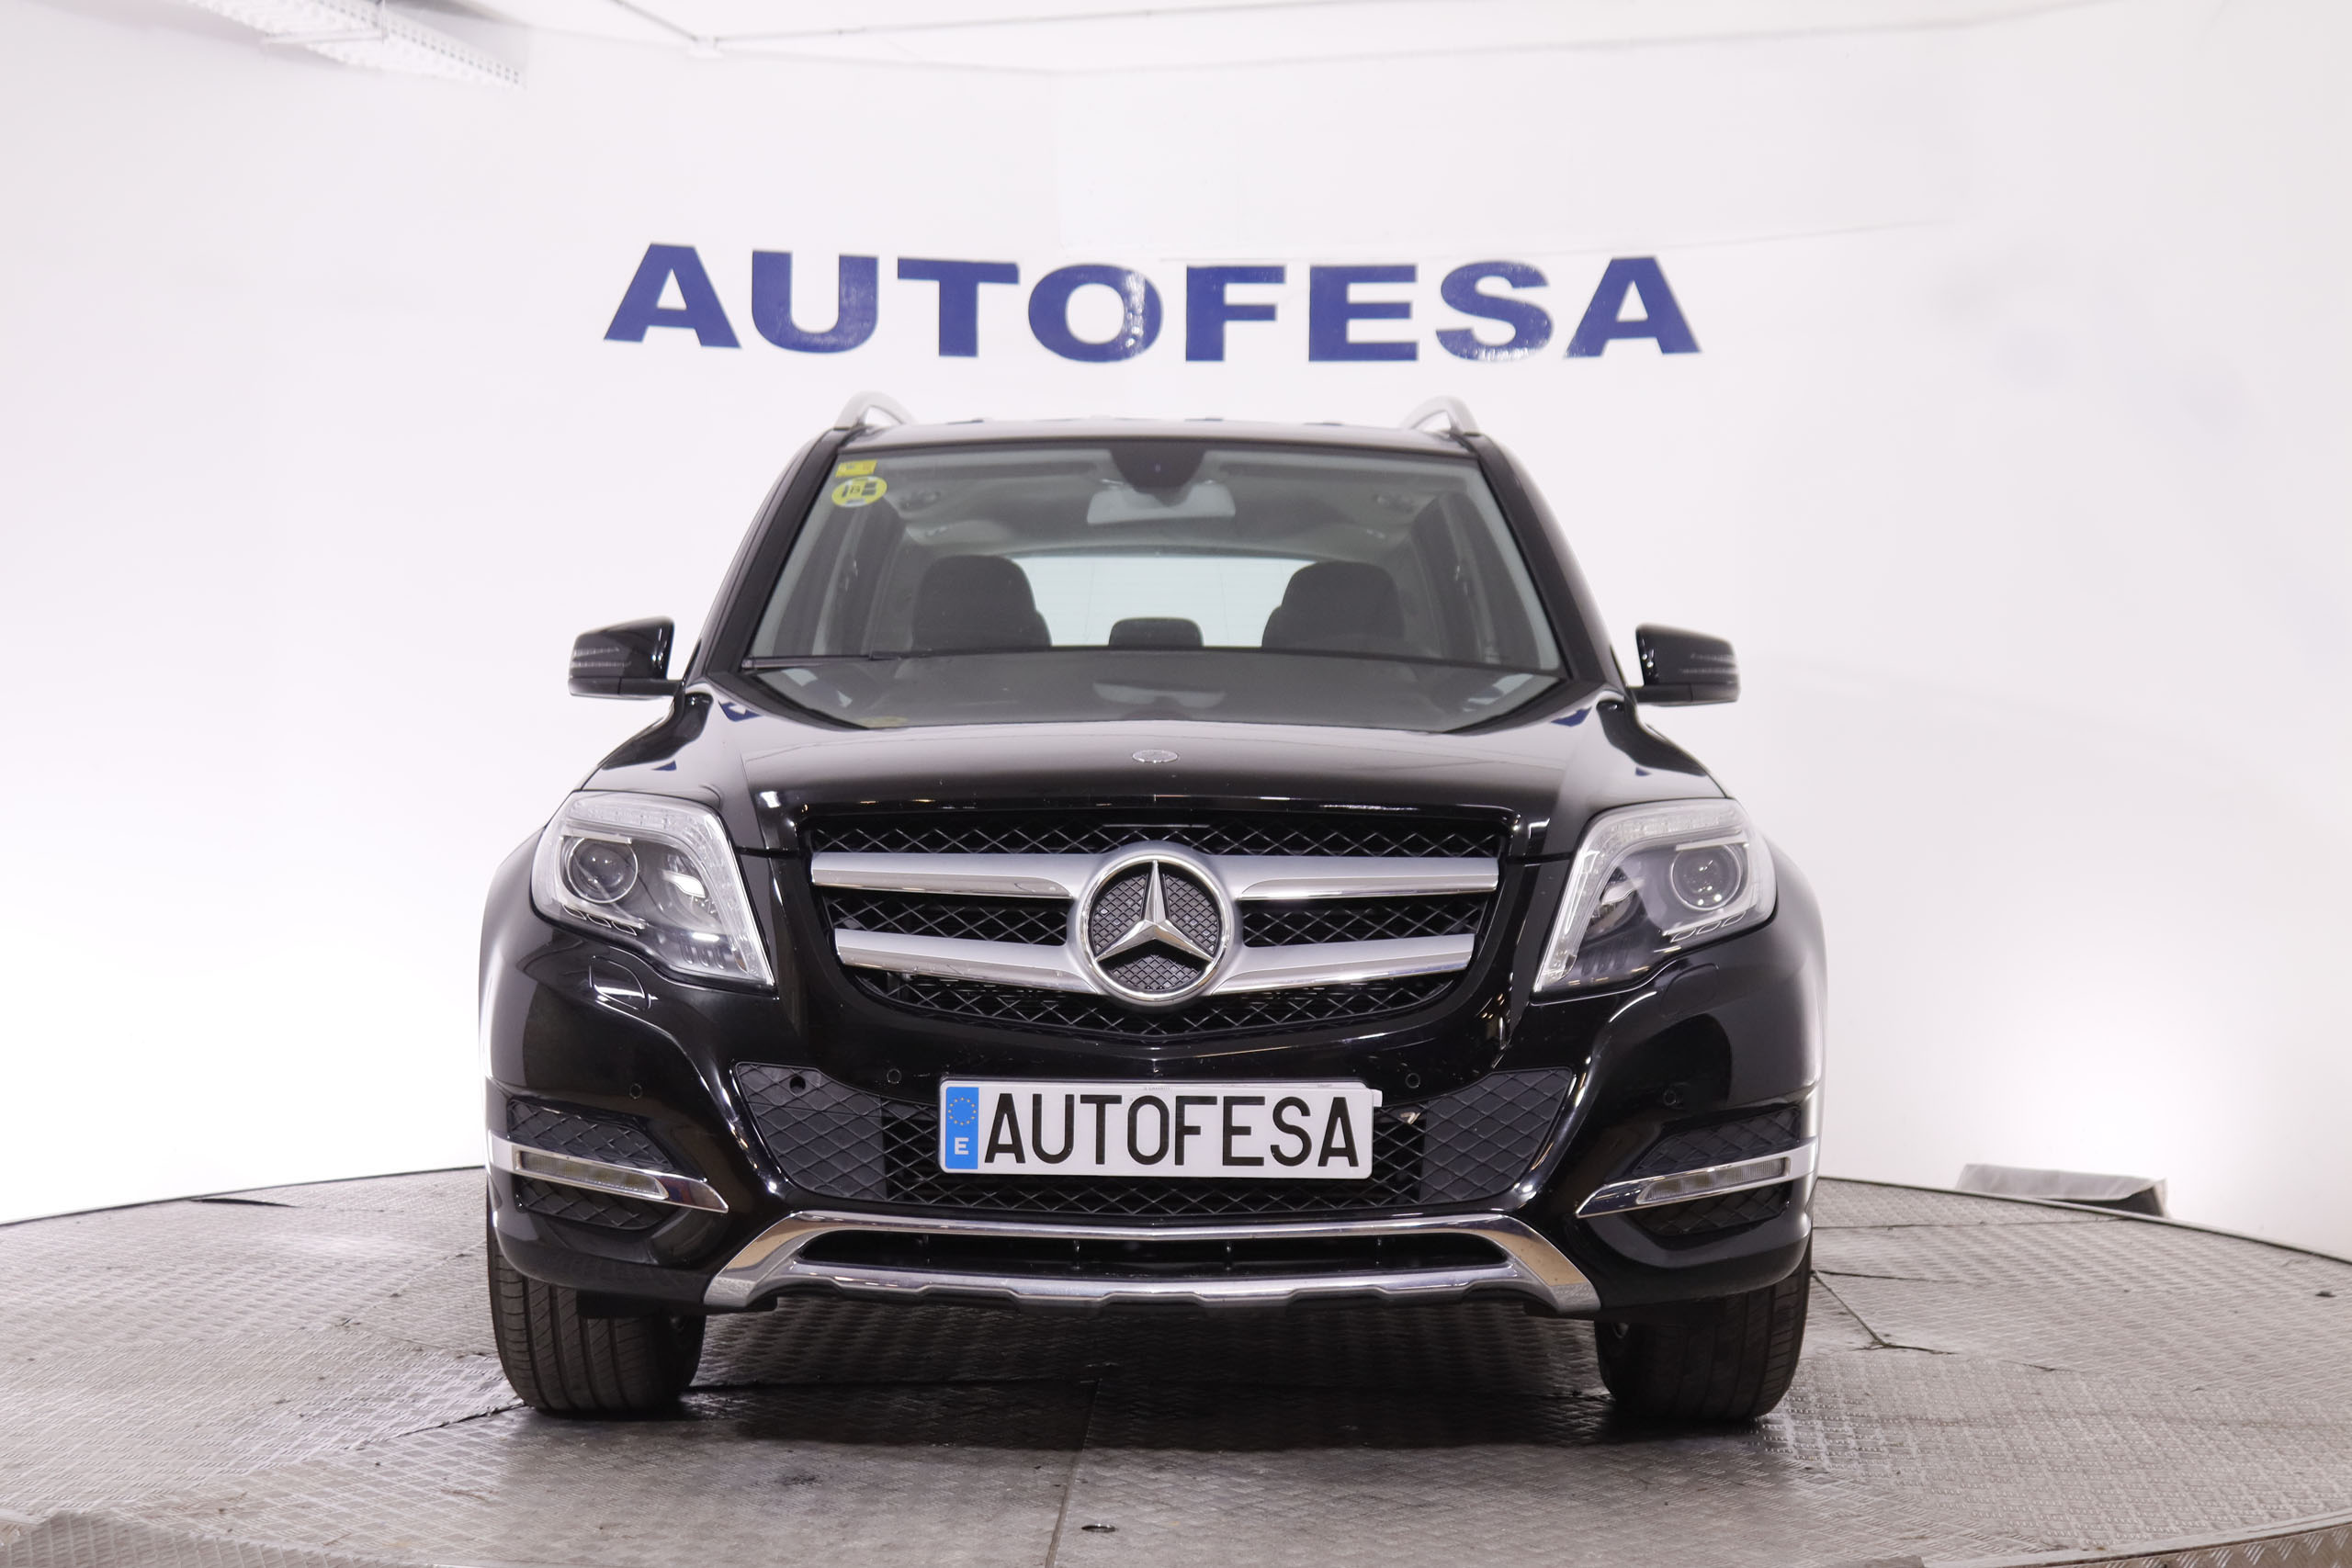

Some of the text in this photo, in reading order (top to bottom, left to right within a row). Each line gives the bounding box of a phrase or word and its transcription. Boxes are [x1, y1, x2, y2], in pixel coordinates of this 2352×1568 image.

[605, 243, 1701, 363] AUTOFESA
[954, 1092, 1359, 1168] E AUTOFESA
